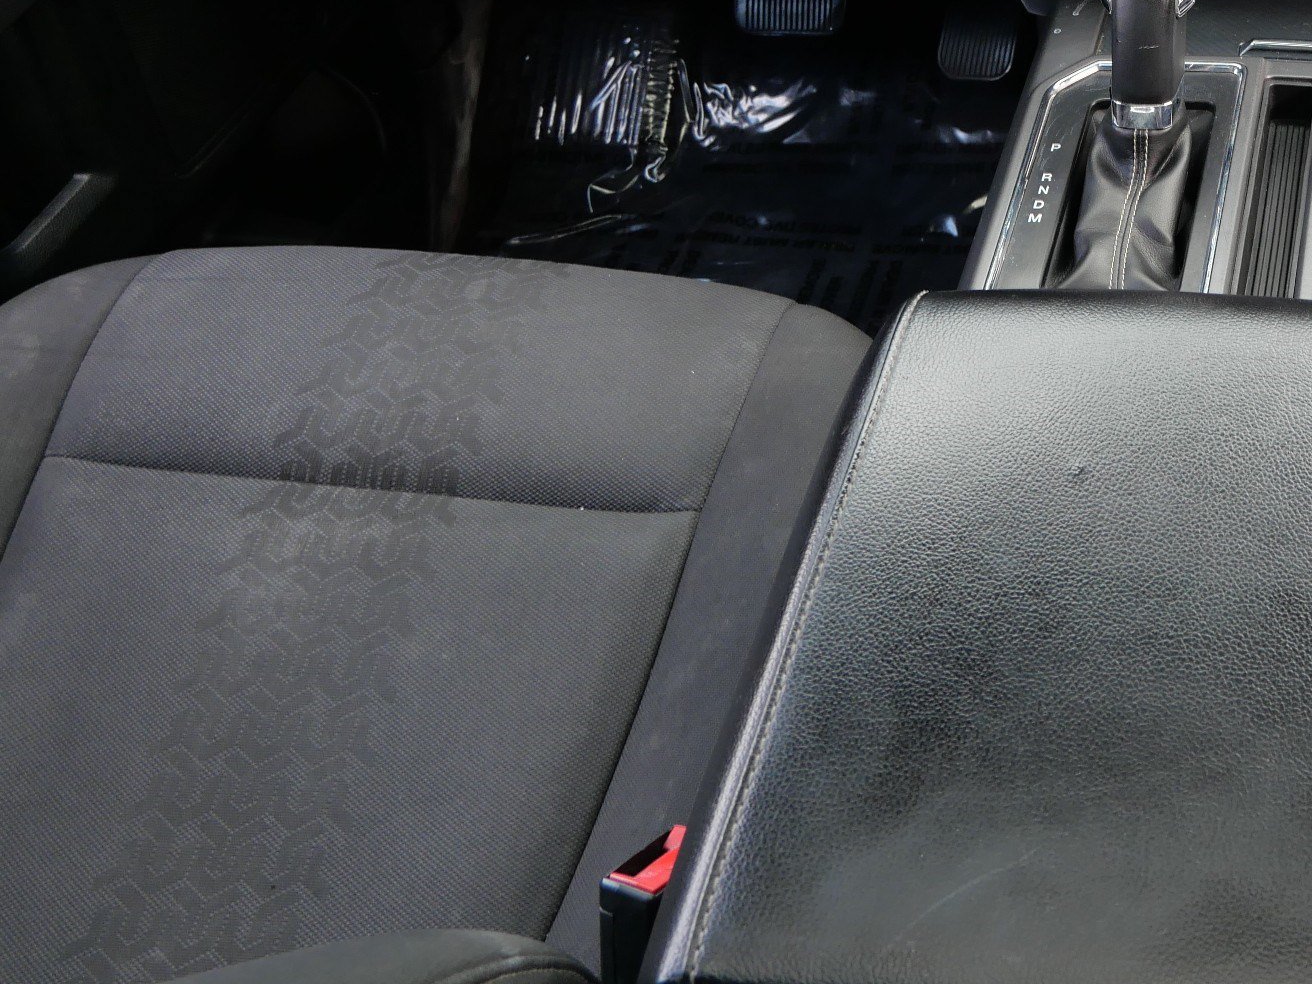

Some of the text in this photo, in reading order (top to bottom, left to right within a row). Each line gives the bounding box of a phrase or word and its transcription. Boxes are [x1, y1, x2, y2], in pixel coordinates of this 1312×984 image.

[1050, 143, 1062, 152] P
[1041, 173, 1053, 182] R
[1037, 186, 1050, 195] N
[1033, 200, 1045, 209] D
[1027, 213, 1043, 223] M
